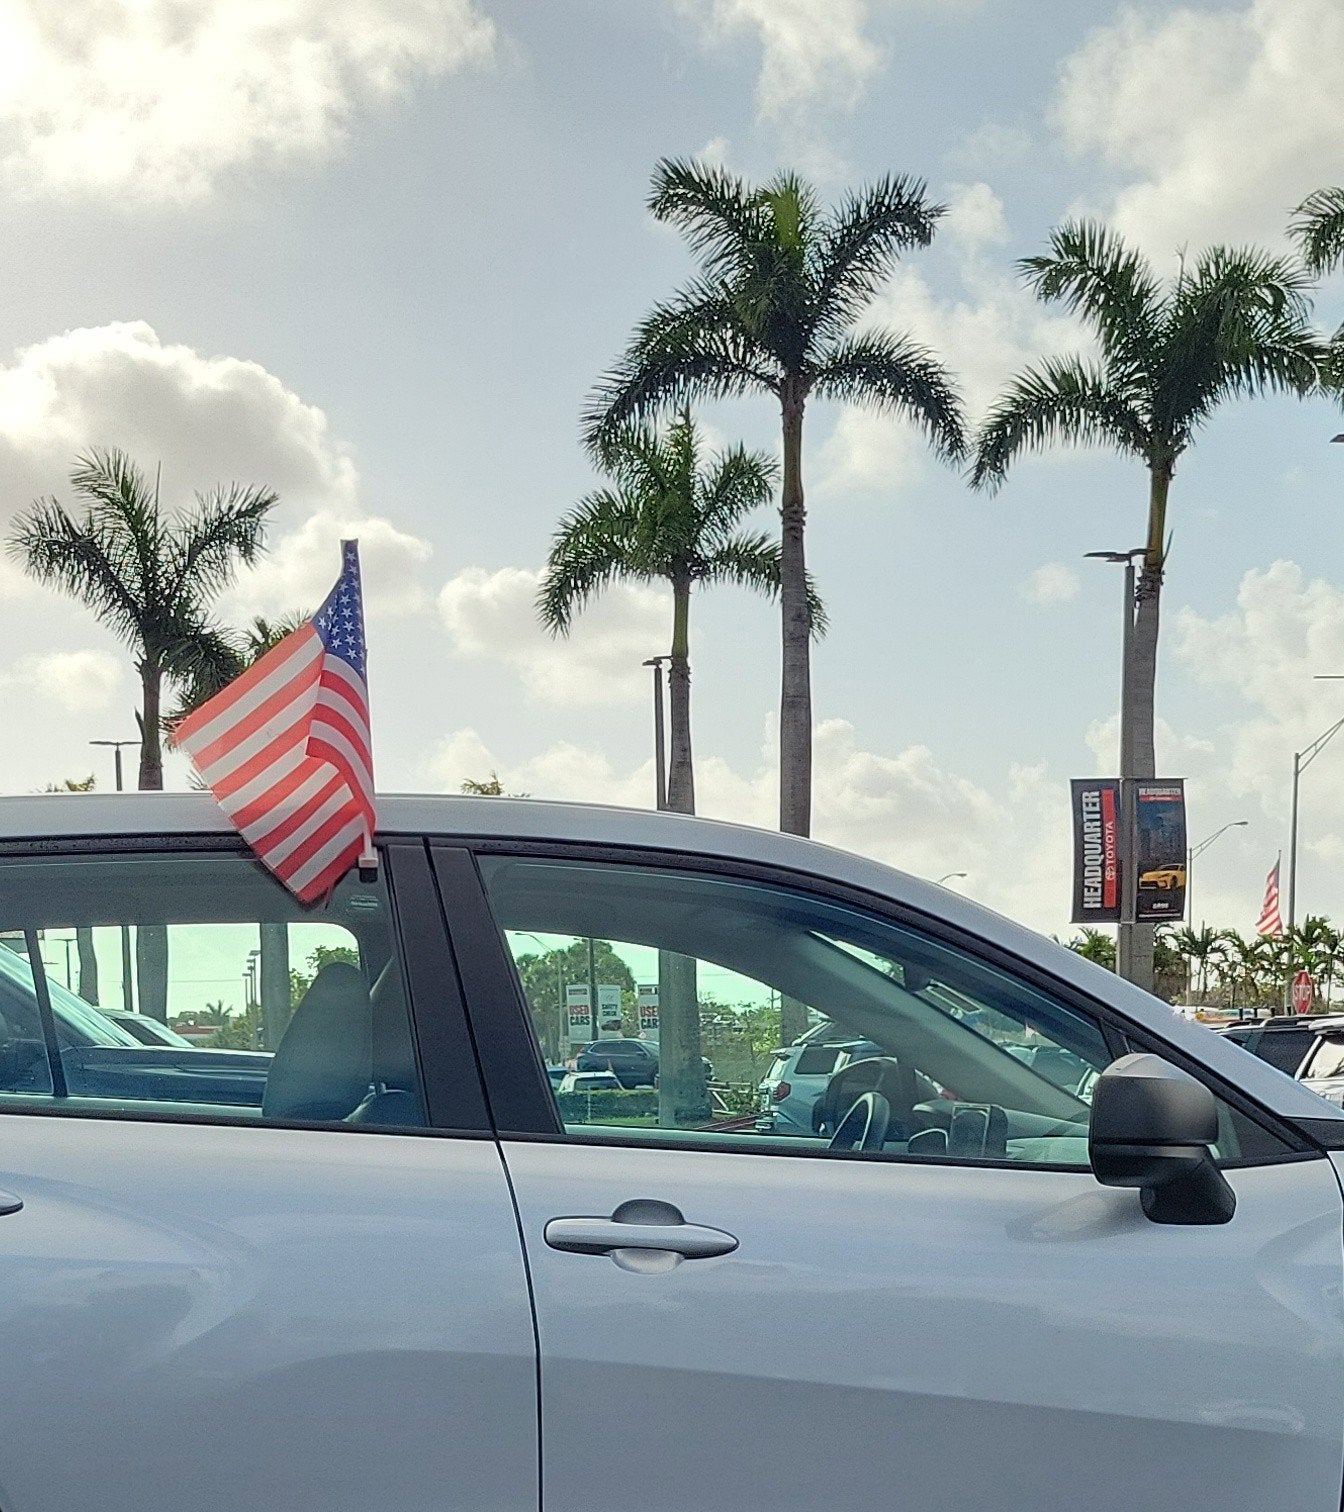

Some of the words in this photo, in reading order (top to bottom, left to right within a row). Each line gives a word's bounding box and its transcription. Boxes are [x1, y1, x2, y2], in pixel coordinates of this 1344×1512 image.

[1082, 791, 1104, 908] HEADQUARTER
[1105, 821, 1115, 865] TOYOTA
[640, 1006, 659, 1017] USE
[641, 1018, 659, 1029] CAR
